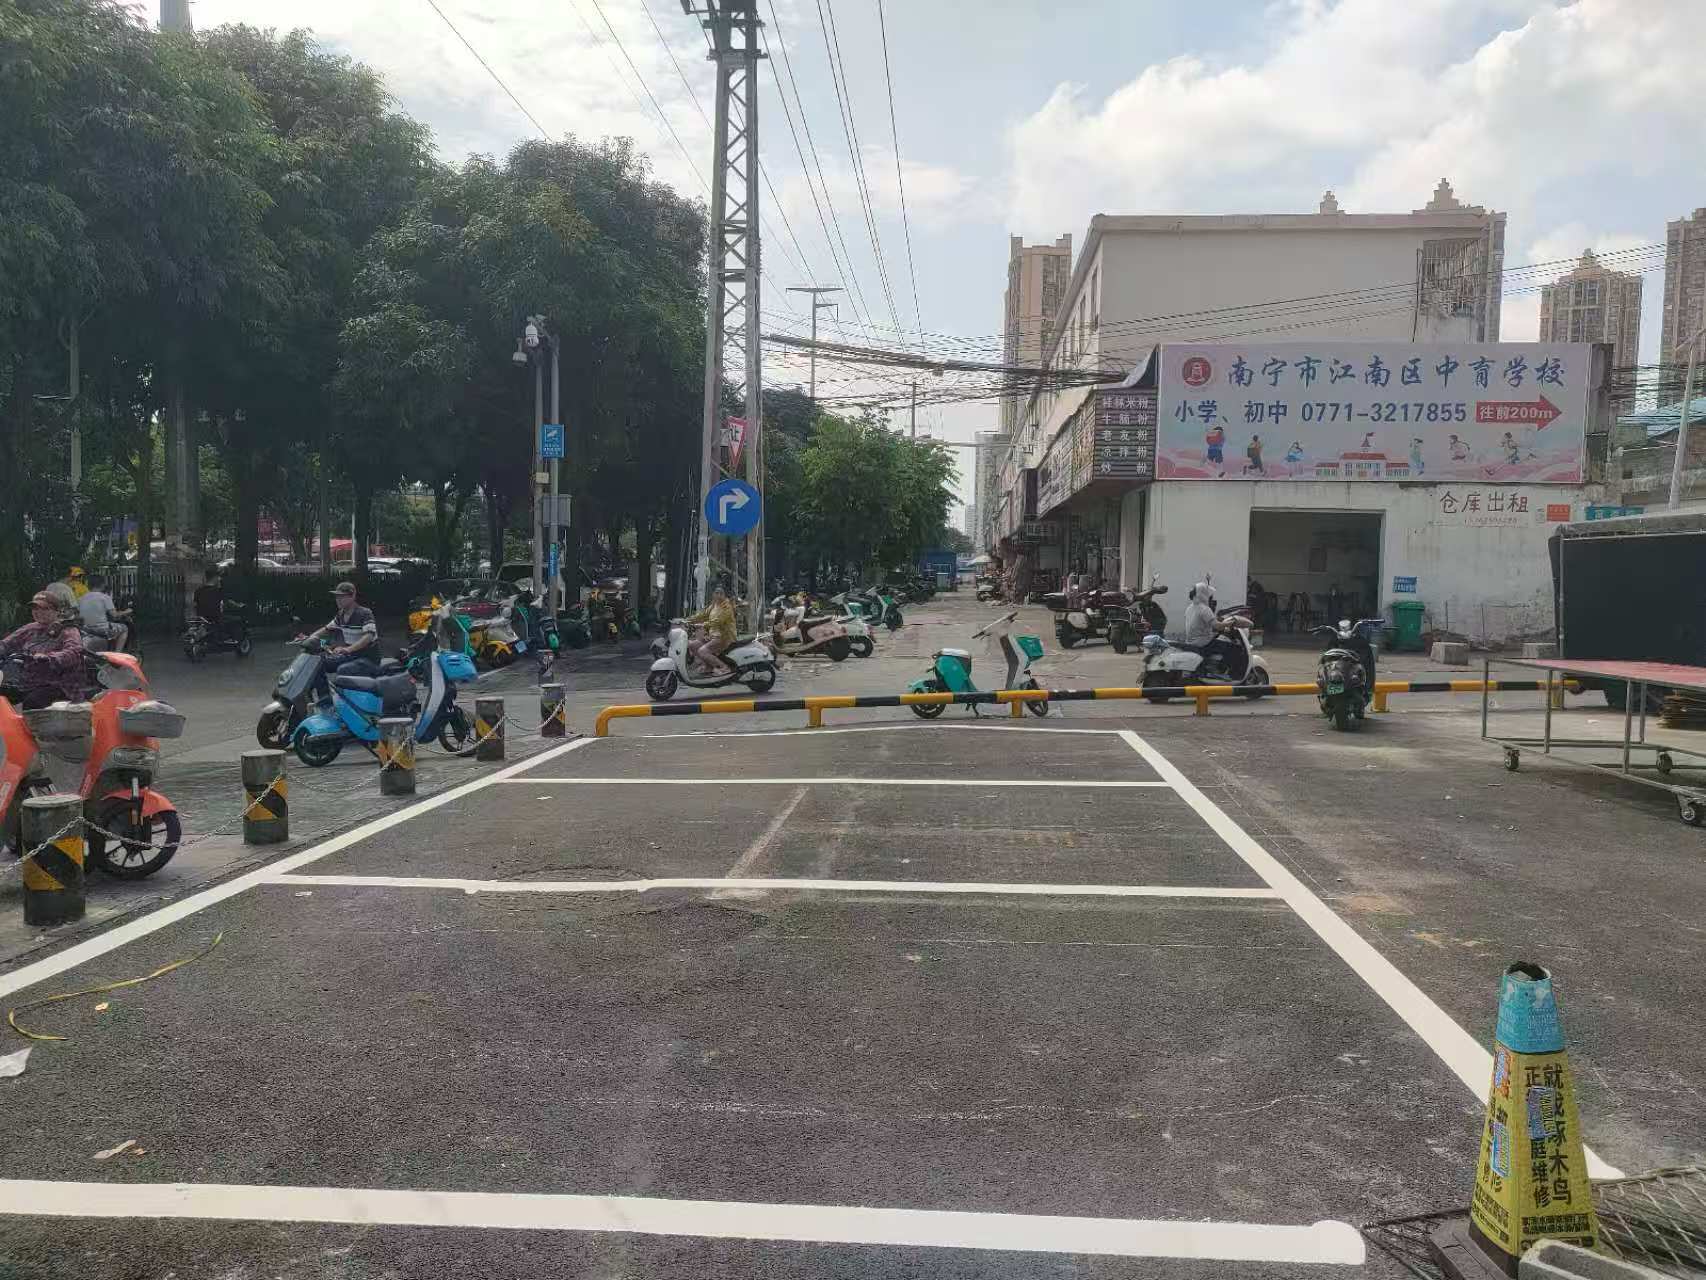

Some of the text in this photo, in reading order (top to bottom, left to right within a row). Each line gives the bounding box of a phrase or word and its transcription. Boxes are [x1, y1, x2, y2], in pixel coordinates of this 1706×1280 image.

[1227, 355, 1565, 389] 南宁市江南区中育学校
[1301, 402, 1467, 423] 0771-3217855
[1479, 404, 1553, 420] 往前200m
[1439, 490, 1529, 513] 仓库出租
